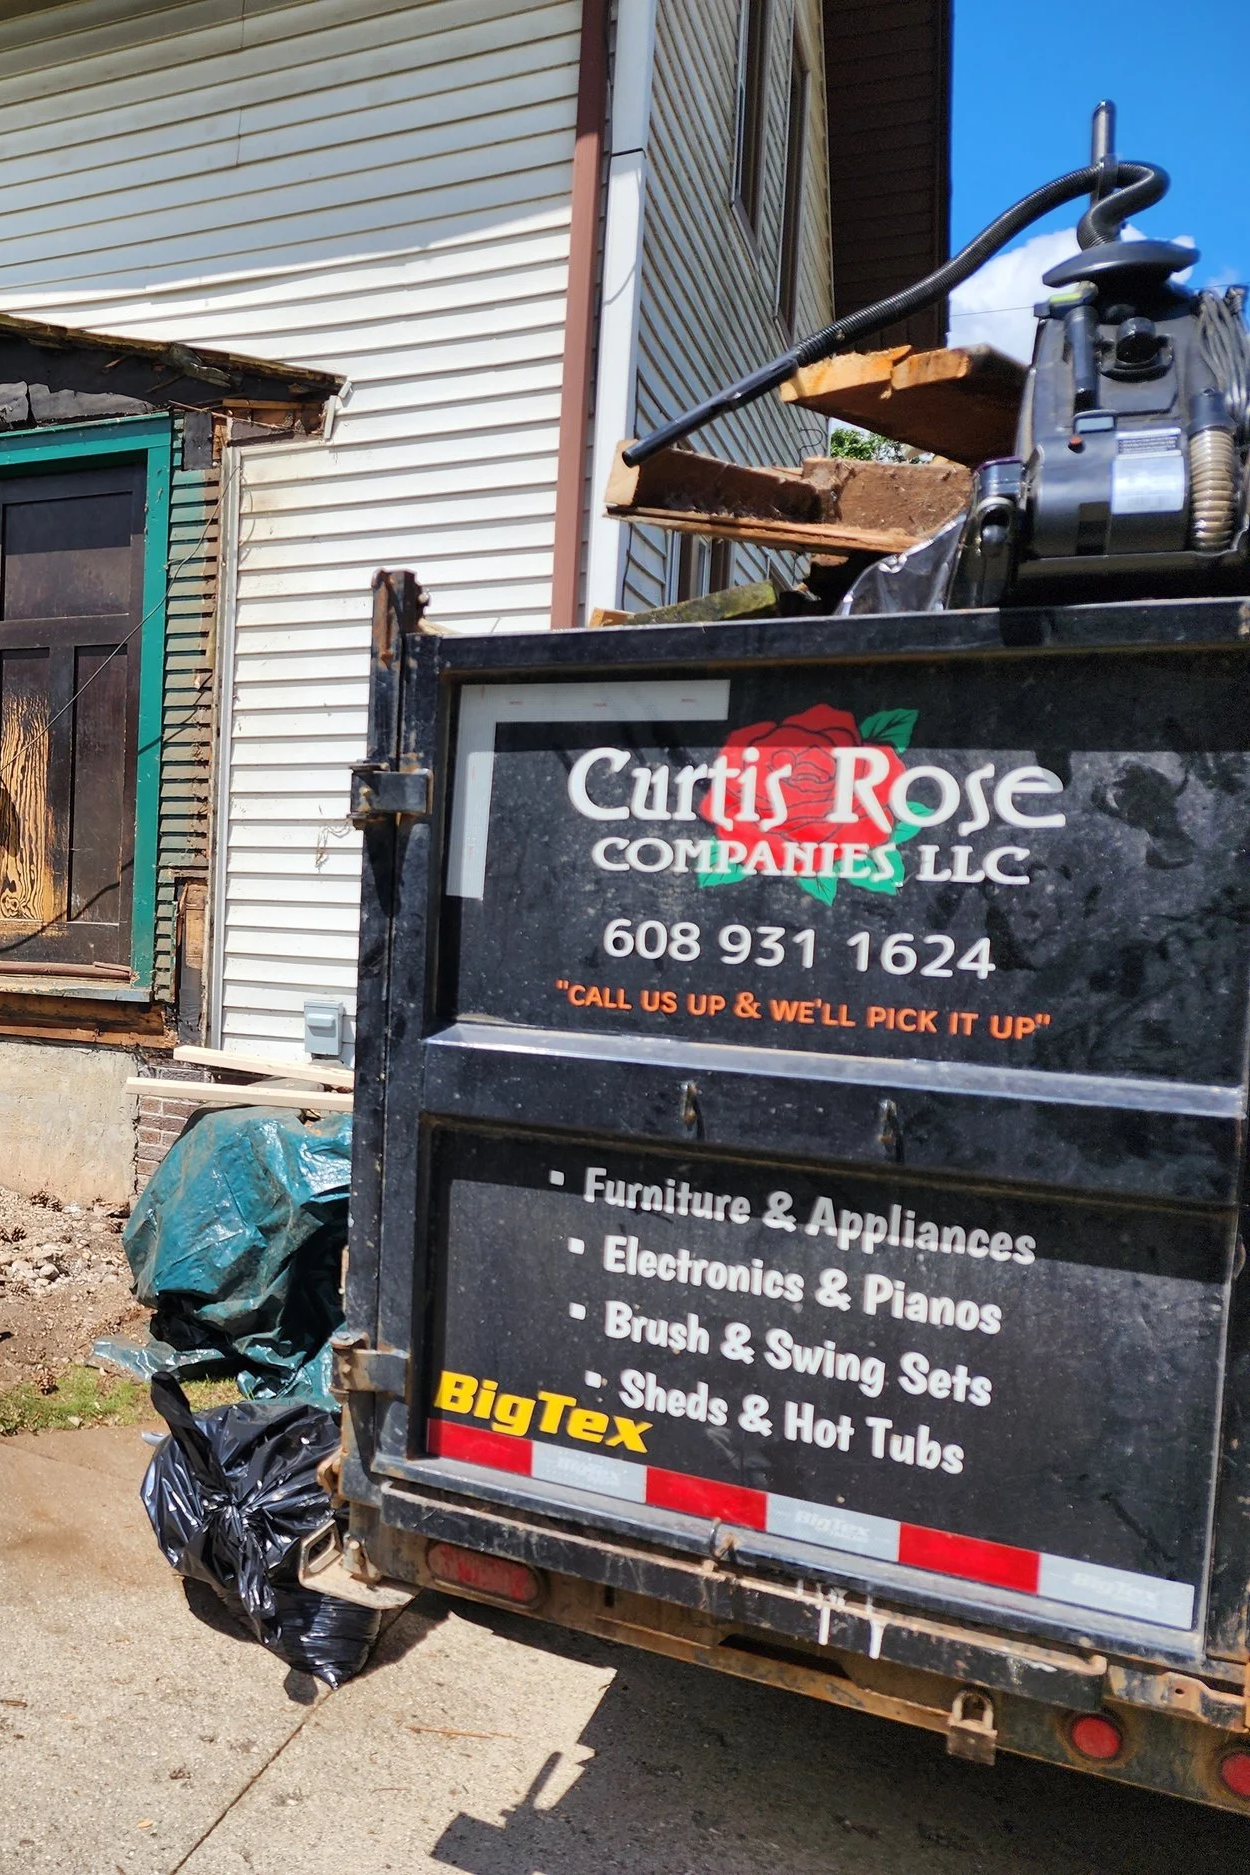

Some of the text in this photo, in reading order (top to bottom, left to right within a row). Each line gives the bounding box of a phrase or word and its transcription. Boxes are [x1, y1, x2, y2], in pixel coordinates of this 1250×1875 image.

[567, 745, 1066, 837] Curtis Rose
[591, 835, 1031, 886] COMPANIES LLC
[603, 918, 996, 980] 608 931 1624
[556, 979, 1052, 1041] "CALL US UP & WE'LL PICK IT UP"
[582, 1166, 1036, 1266] Furniture & Appliances
[602, 1234, 1003, 1335] Electronics & Pianos
[604, 1299, 993, 1407] Brush & Swing Sets
[434, 1370, 651, 1455] BigTex
[618, 1369, 966, 1476] Sheds & Hot Tubs
